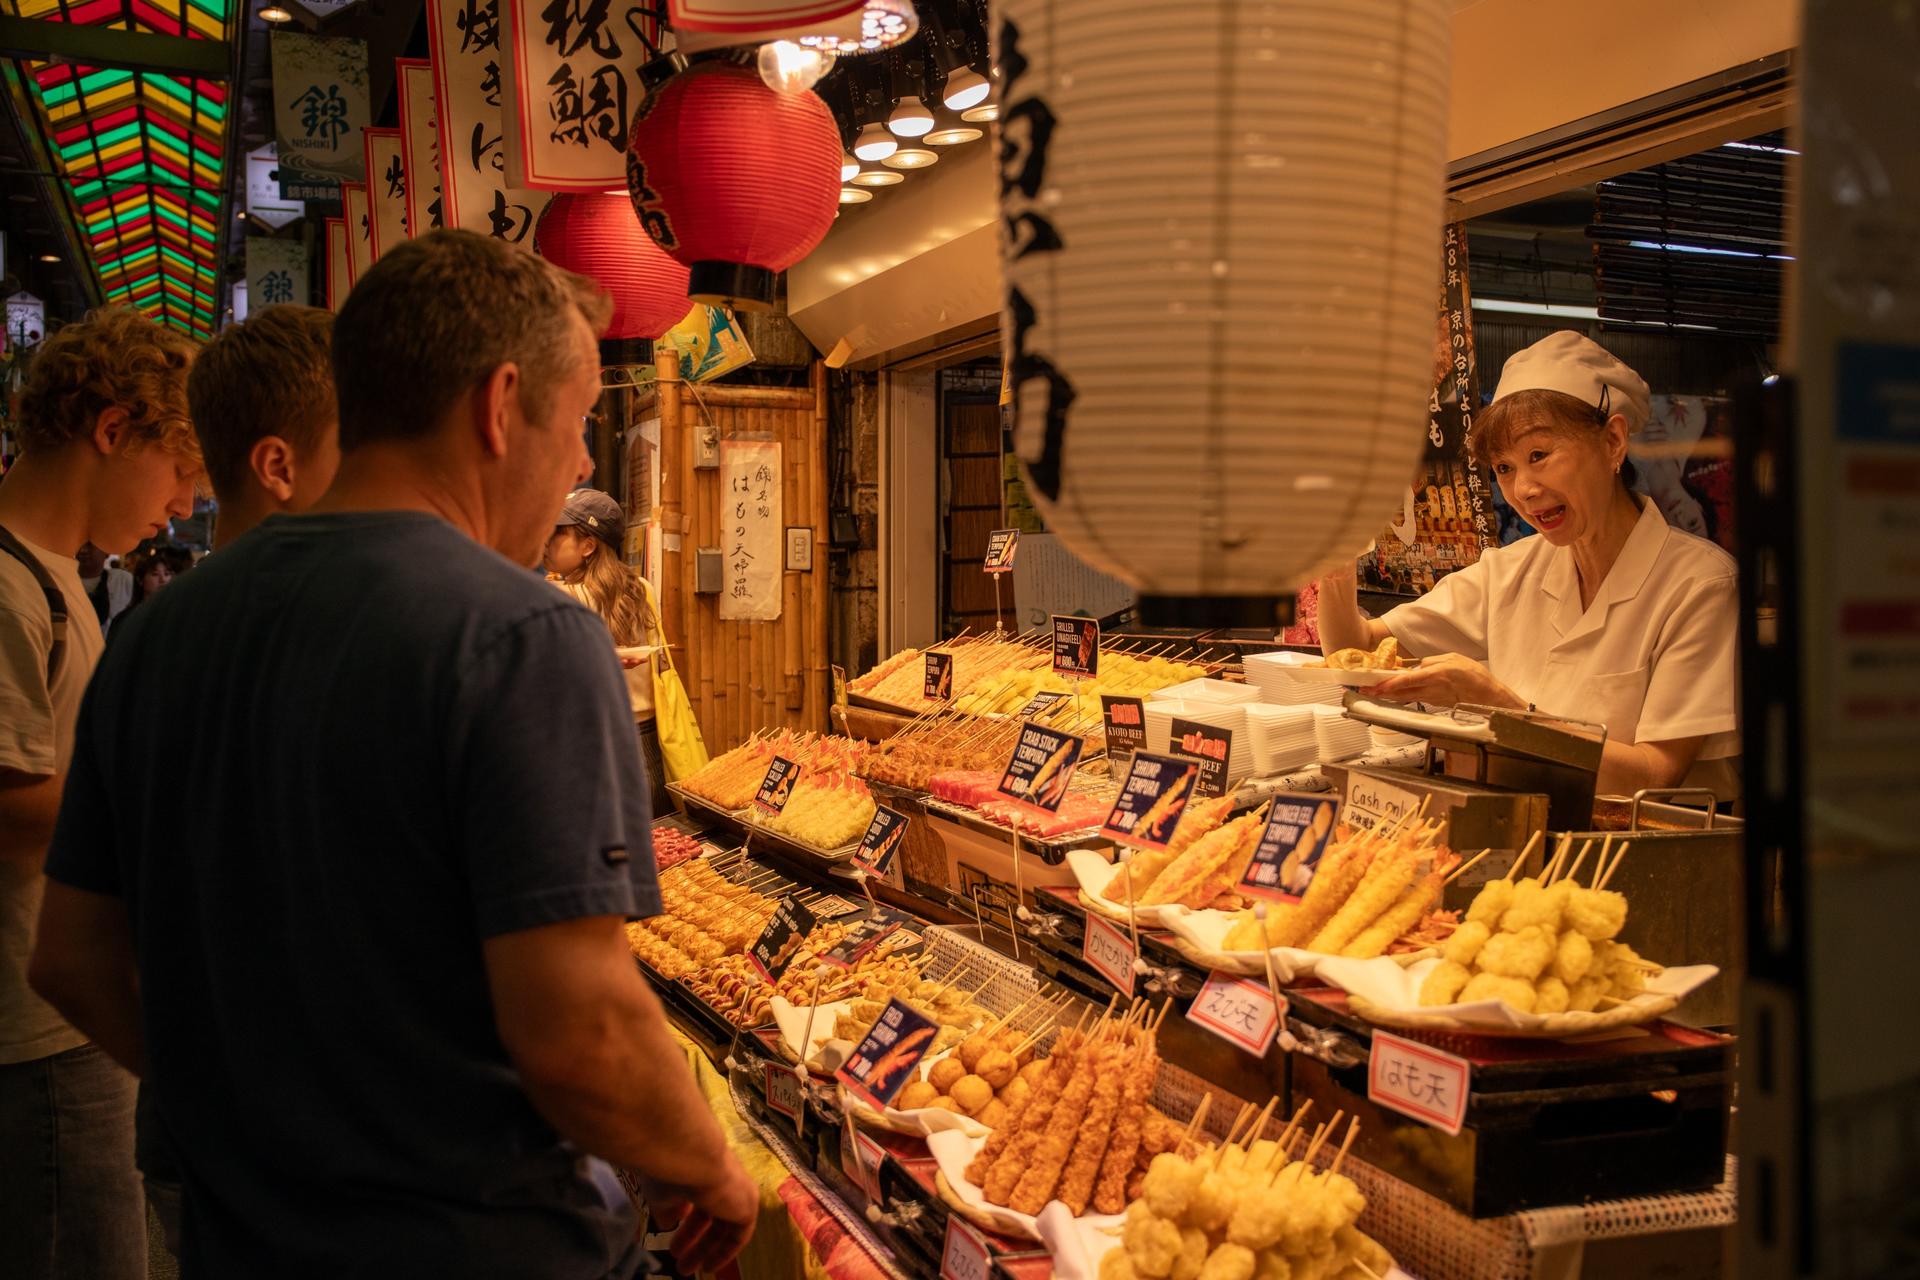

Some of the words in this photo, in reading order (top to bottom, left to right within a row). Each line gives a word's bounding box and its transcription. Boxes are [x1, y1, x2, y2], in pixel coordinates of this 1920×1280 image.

[289, 84, 351, 152] 錦
[291, 138, 330, 150] NISHIKI
[256, 270, 294, 303] 錦
[729, 475, 755, 599] はもの天婦羅
[1056, 621, 1075, 633] GRILLED
[1022, 729, 1040, 747] CRAB
[1038, 733, 1060, 753] STICK
[1107, 726, 1128, 739] KYOTO
[1128, 729, 1143, 740] BEEF
[1016, 743, 1048, 766] TEMPURA
[1132, 759, 1162, 779] SHRIMP
[1126, 775, 1161, 798] TEMPURA
[1352, 785, 1379, 810] Cash
[1265, 822, 1300, 845] TEMPURA
[881, 1005, 904, 1029] FRIED
[1207, 986, 1261, 1032] えび天
[870, 1021, 899, 1047] SHRIMP
[1380, 1060, 1448, 1108] はも天
